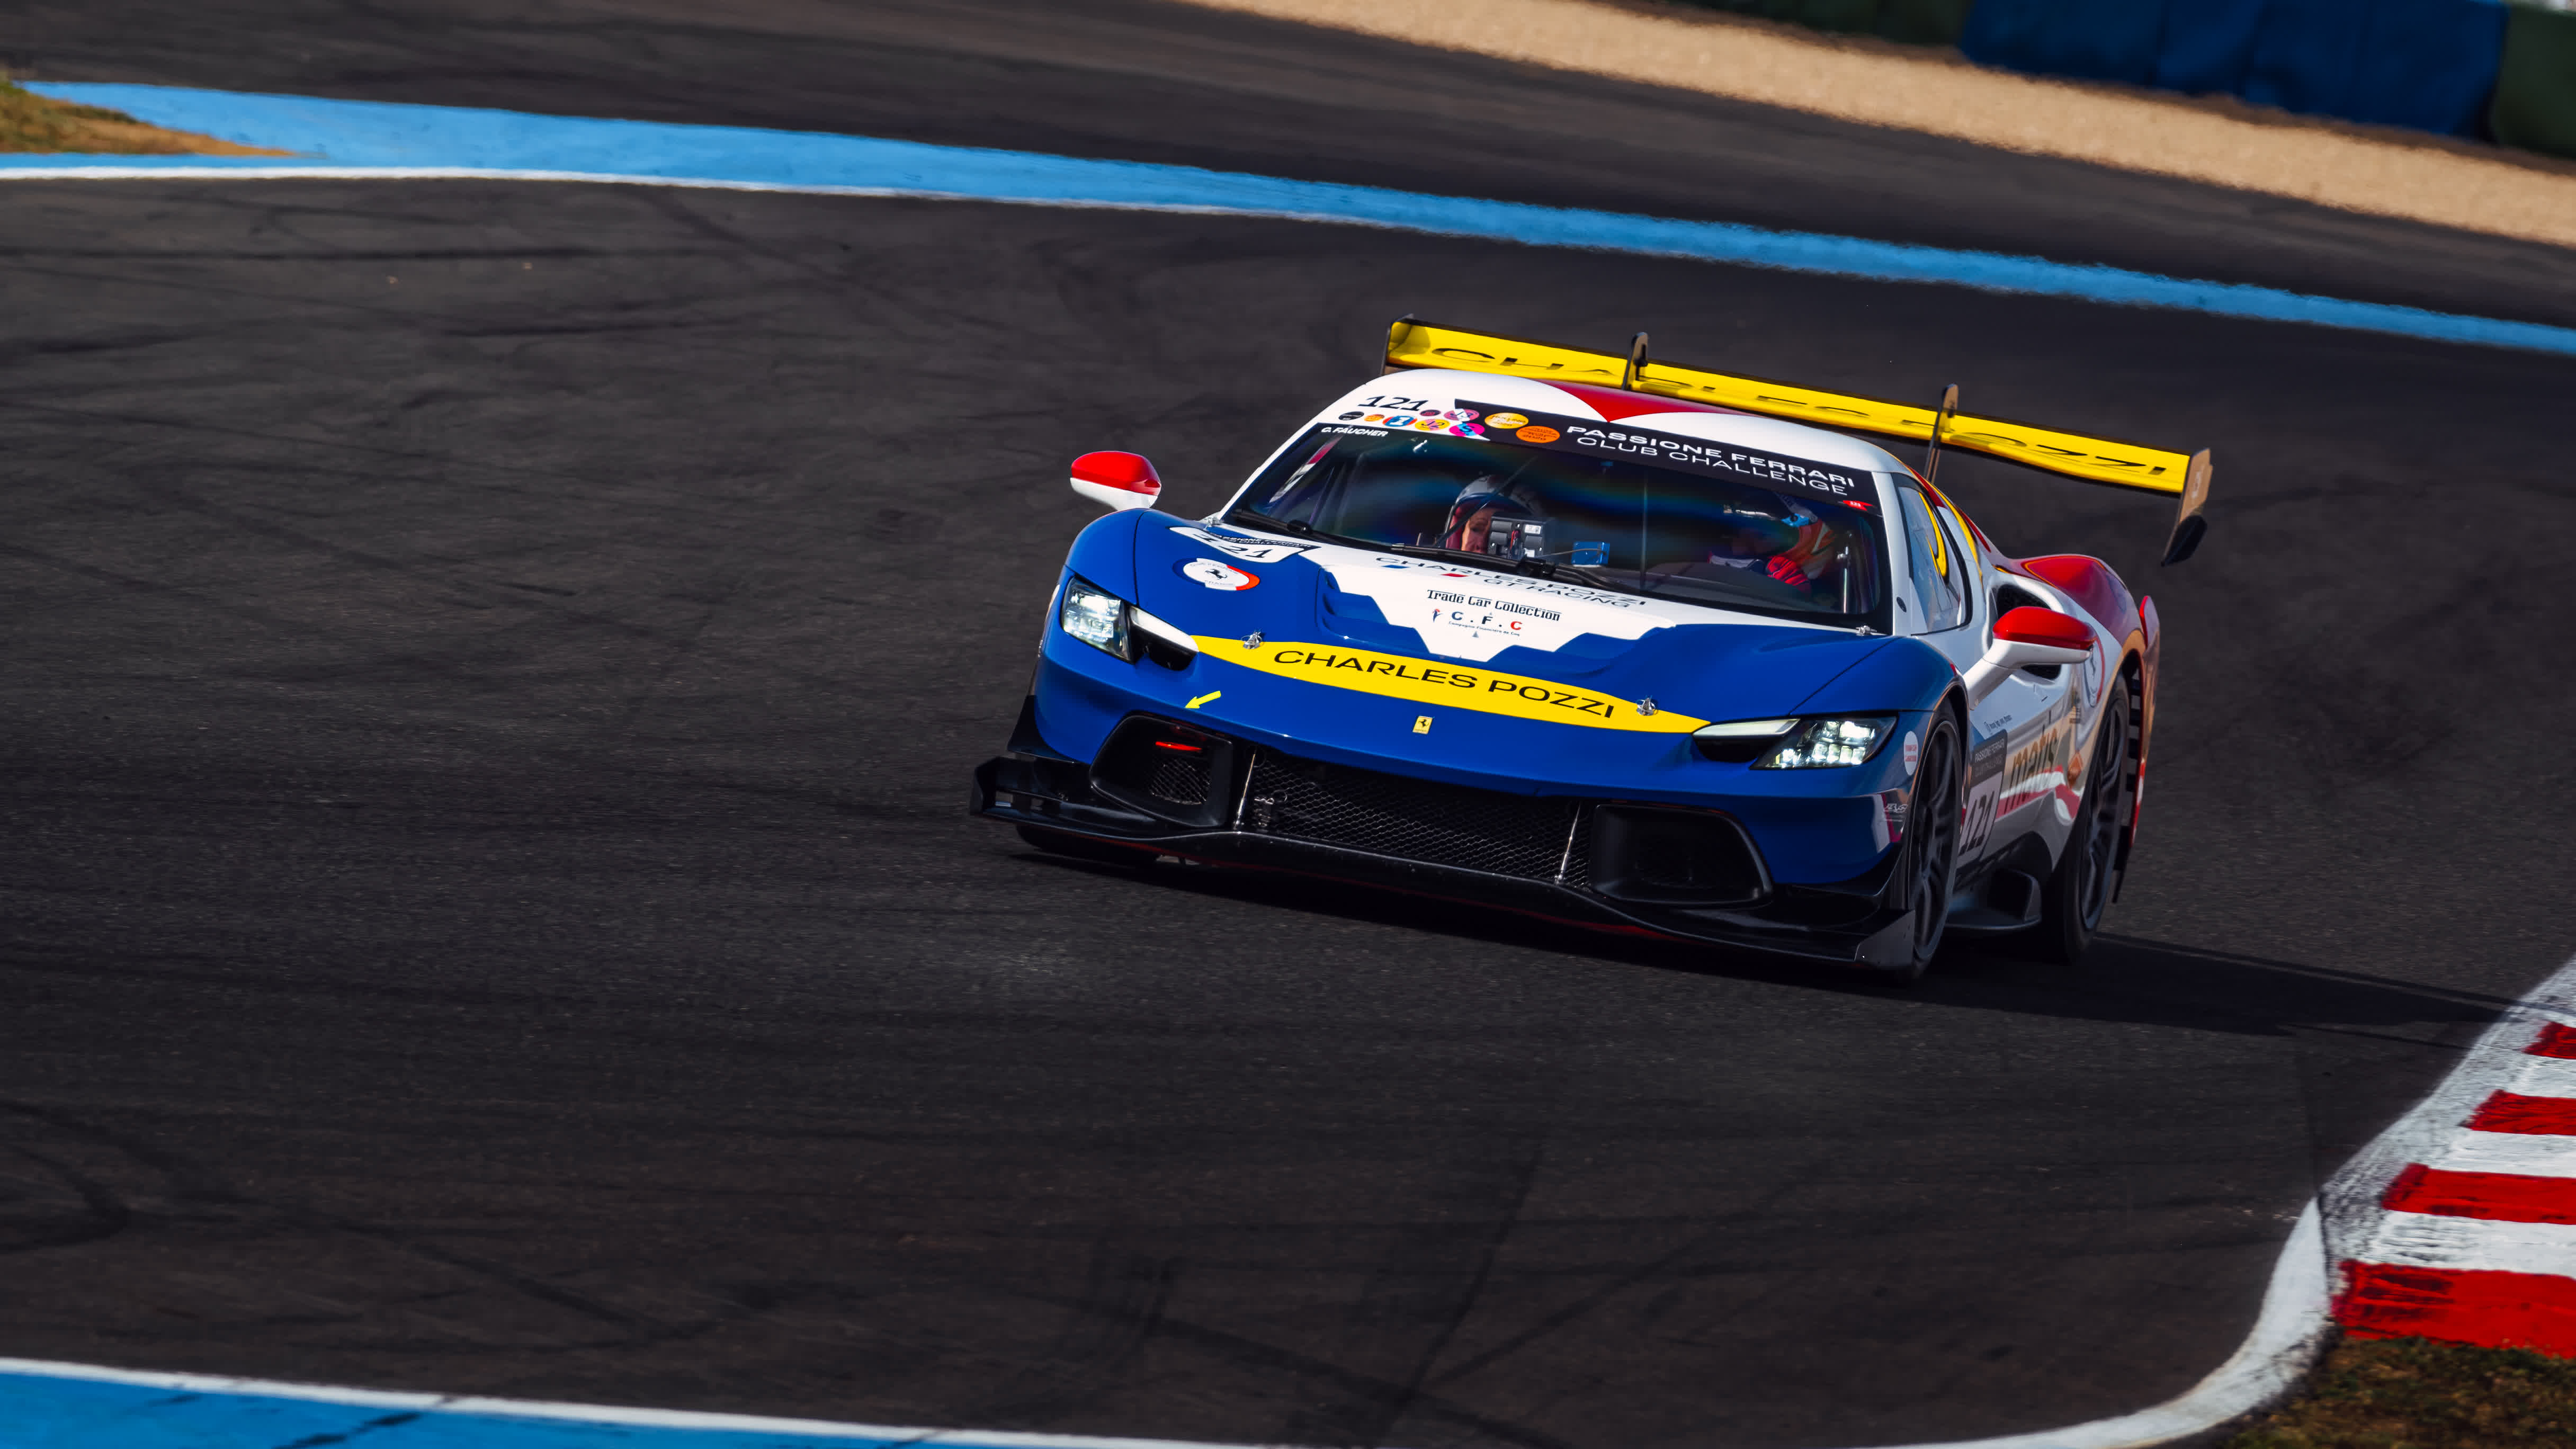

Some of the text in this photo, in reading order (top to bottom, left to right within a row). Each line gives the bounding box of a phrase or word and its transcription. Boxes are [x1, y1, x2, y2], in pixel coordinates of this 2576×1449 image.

[1357, 396, 1429, 411] 121
[1332, 427, 1388, 436] FAUCHER
[1567, 426, 1855, 487] PASSIONE FERRARI
[1577, 437, 1847, 496] CLUB CHALLENGE
[1376, 557, 1646, 605] CHARLES POZZI
[1427, 589, 1562, 621] Trade Car Collection
[1483, 578, 1630, 607] GT RACING
[1274, 651, 1614, 718] CHARLES POZZI
[1958, 790, 1994, 856] 121
